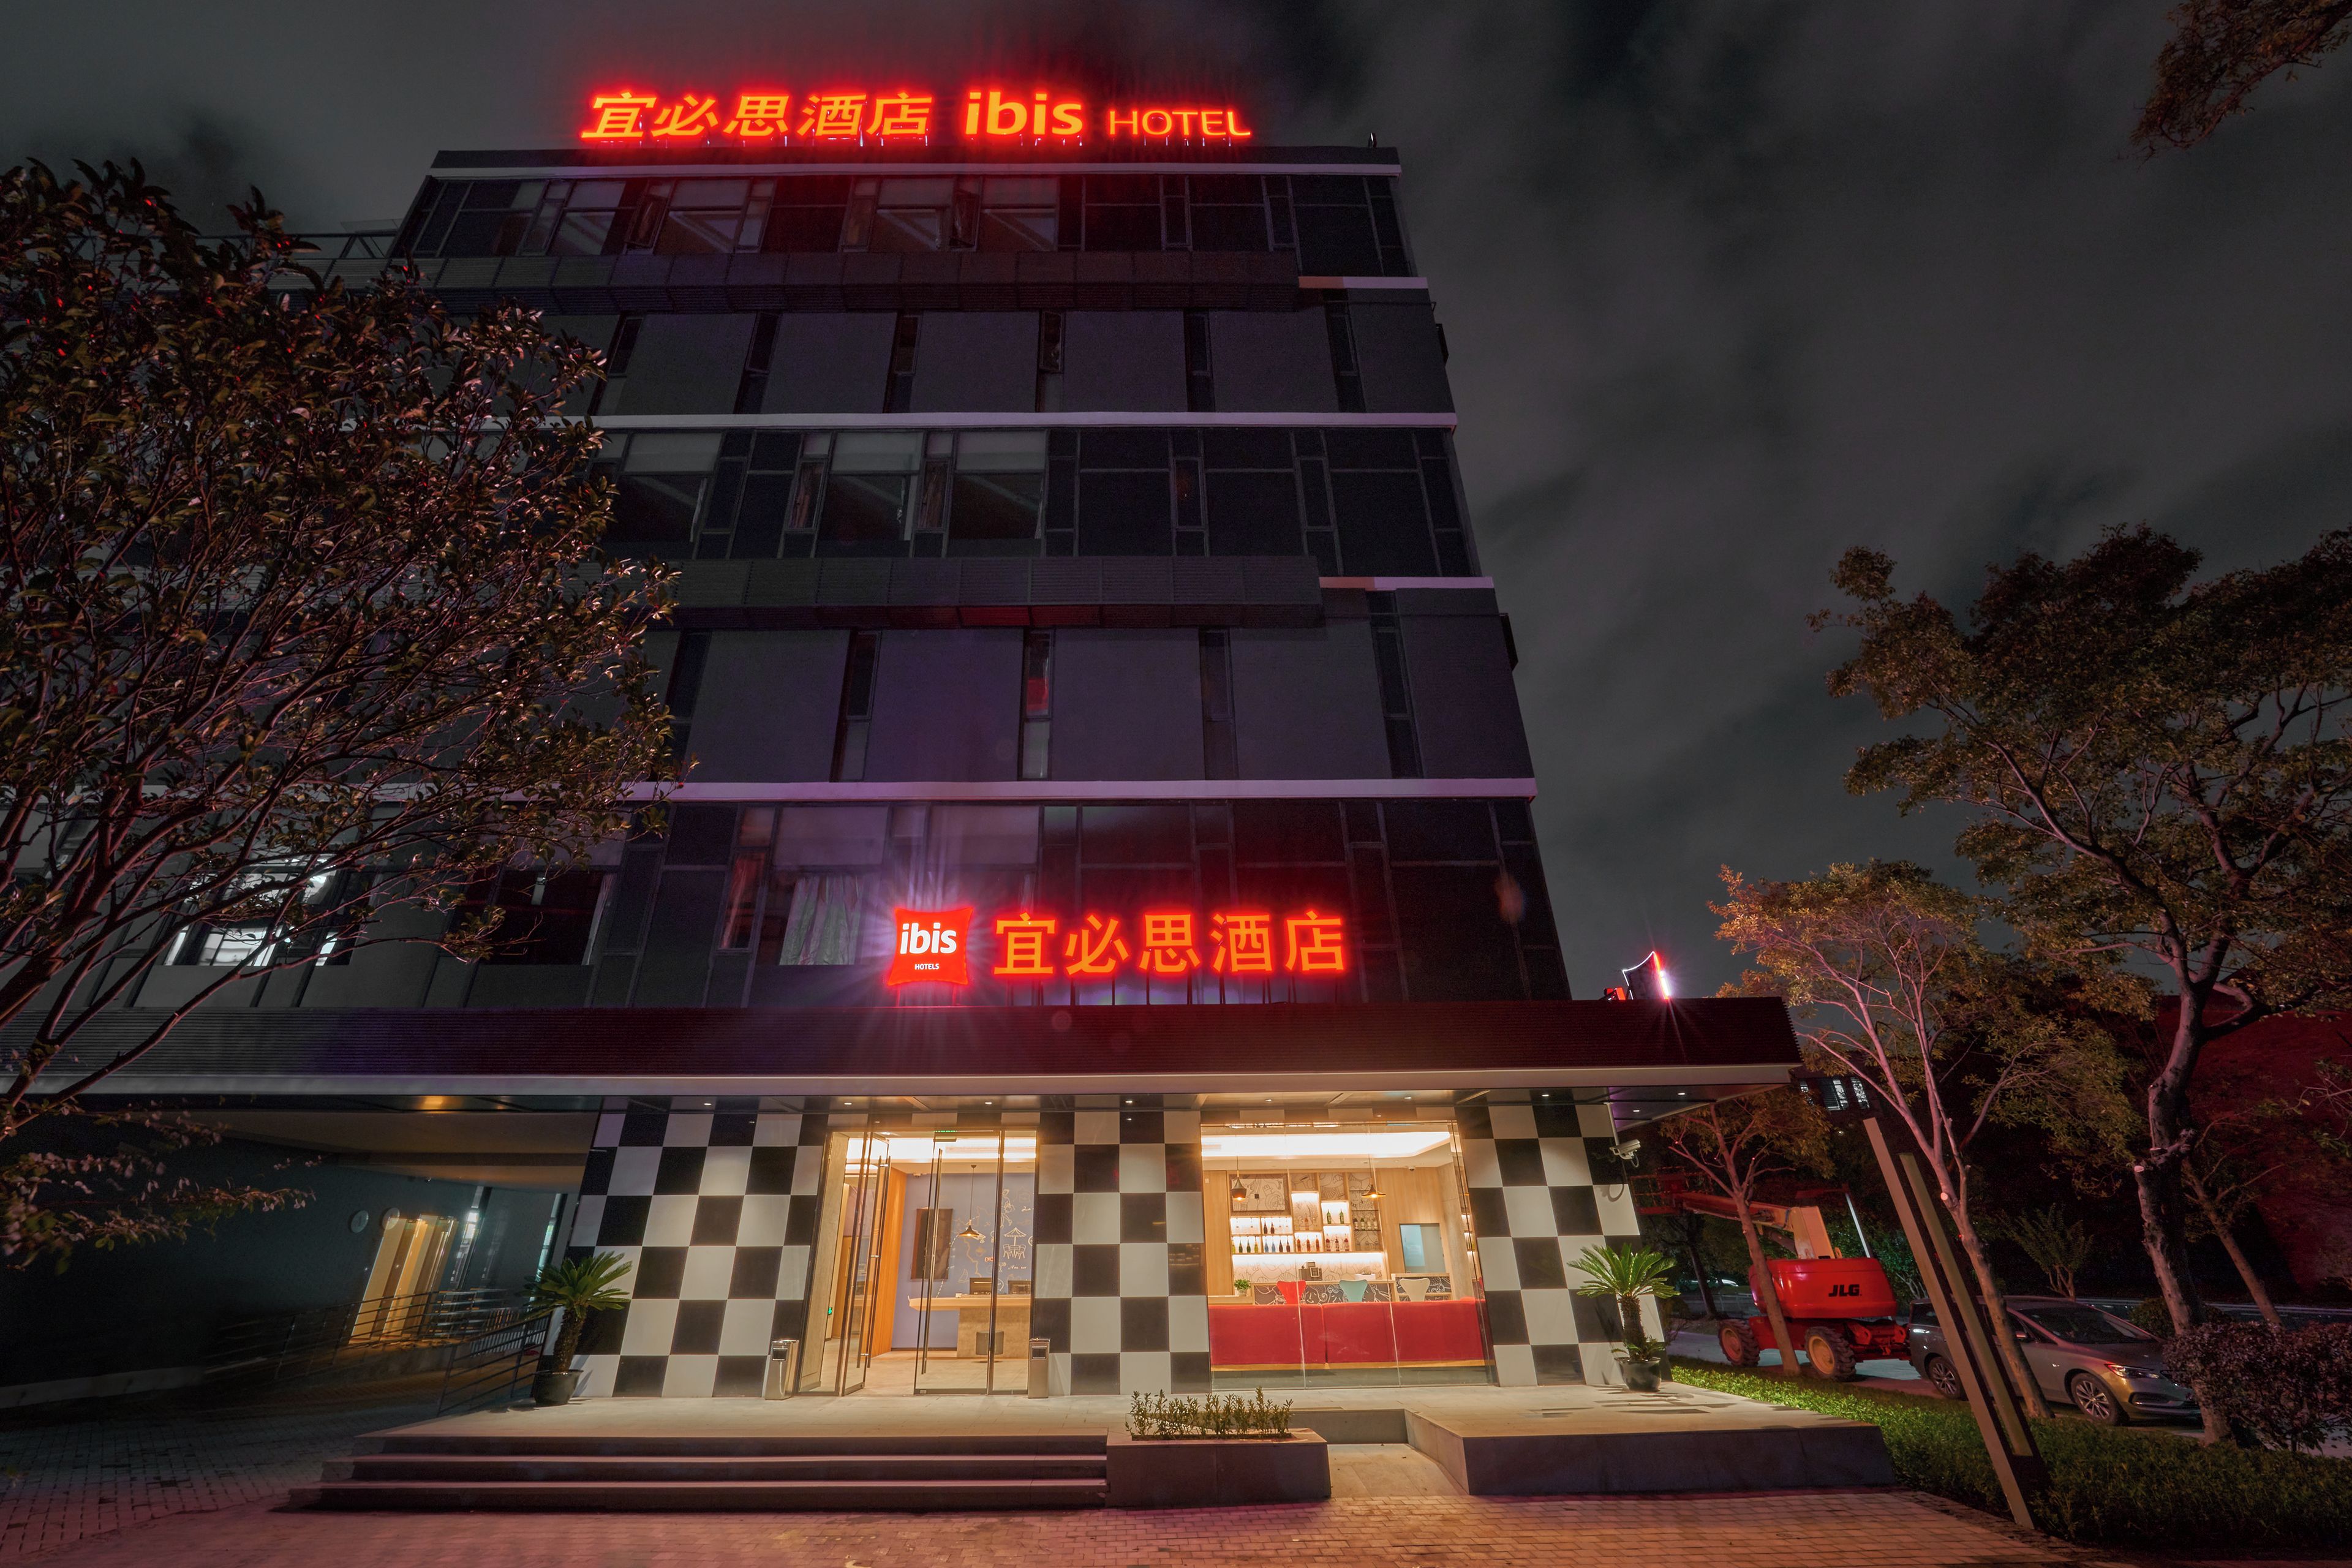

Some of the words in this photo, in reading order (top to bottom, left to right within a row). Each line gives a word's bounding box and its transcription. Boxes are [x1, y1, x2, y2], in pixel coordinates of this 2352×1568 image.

[581, 92, 933, 138] 宜必思酒店
[965, 91, 1084, 135] ibis
[1109, 110, 1251, 136] HOTEL
[900, 922, 957, 954] ibis
[993, 911, 1345, 975] 宜必思酒店
[1828, 1284, 1860, 1297] JLG
